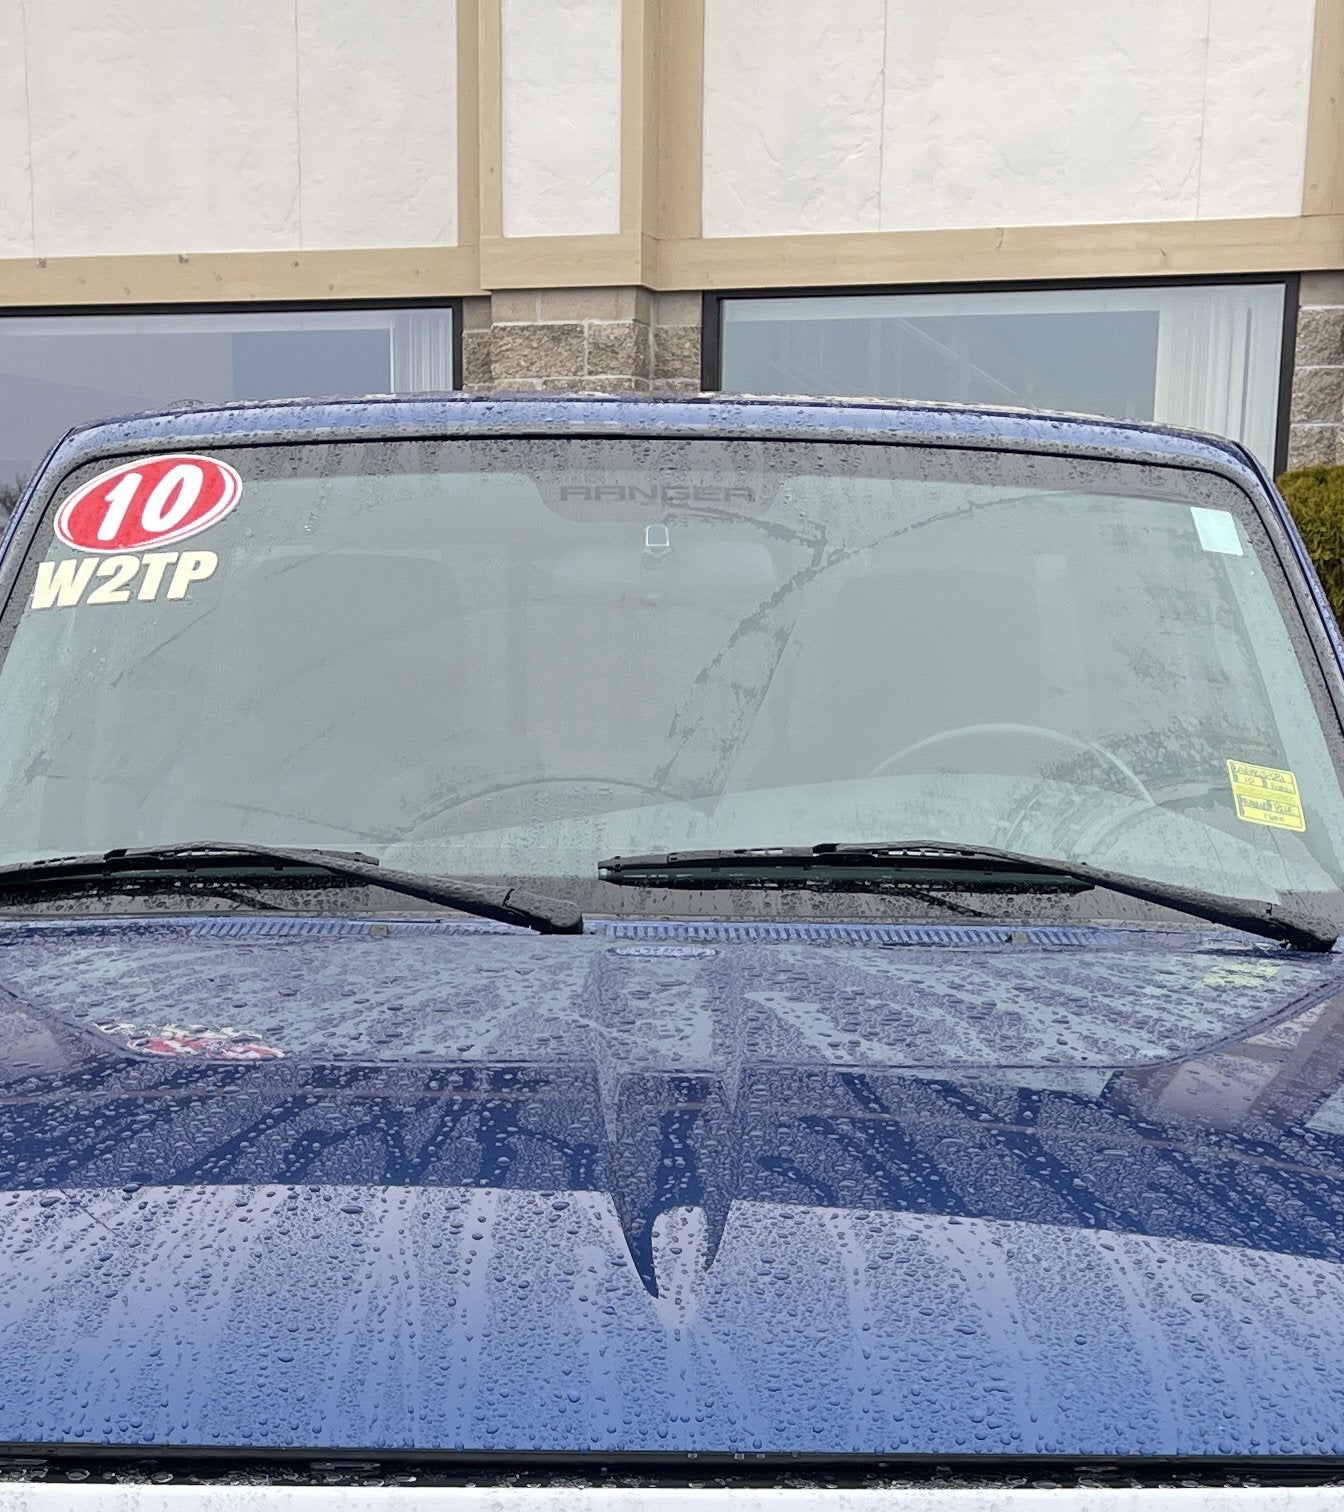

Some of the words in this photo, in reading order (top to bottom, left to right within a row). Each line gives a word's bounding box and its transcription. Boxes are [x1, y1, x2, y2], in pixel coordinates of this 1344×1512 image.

[97, 463, 204, 541] 10
[560, 485, 755, 501] RANGER
[31, 550, 218, 610] W2TP
